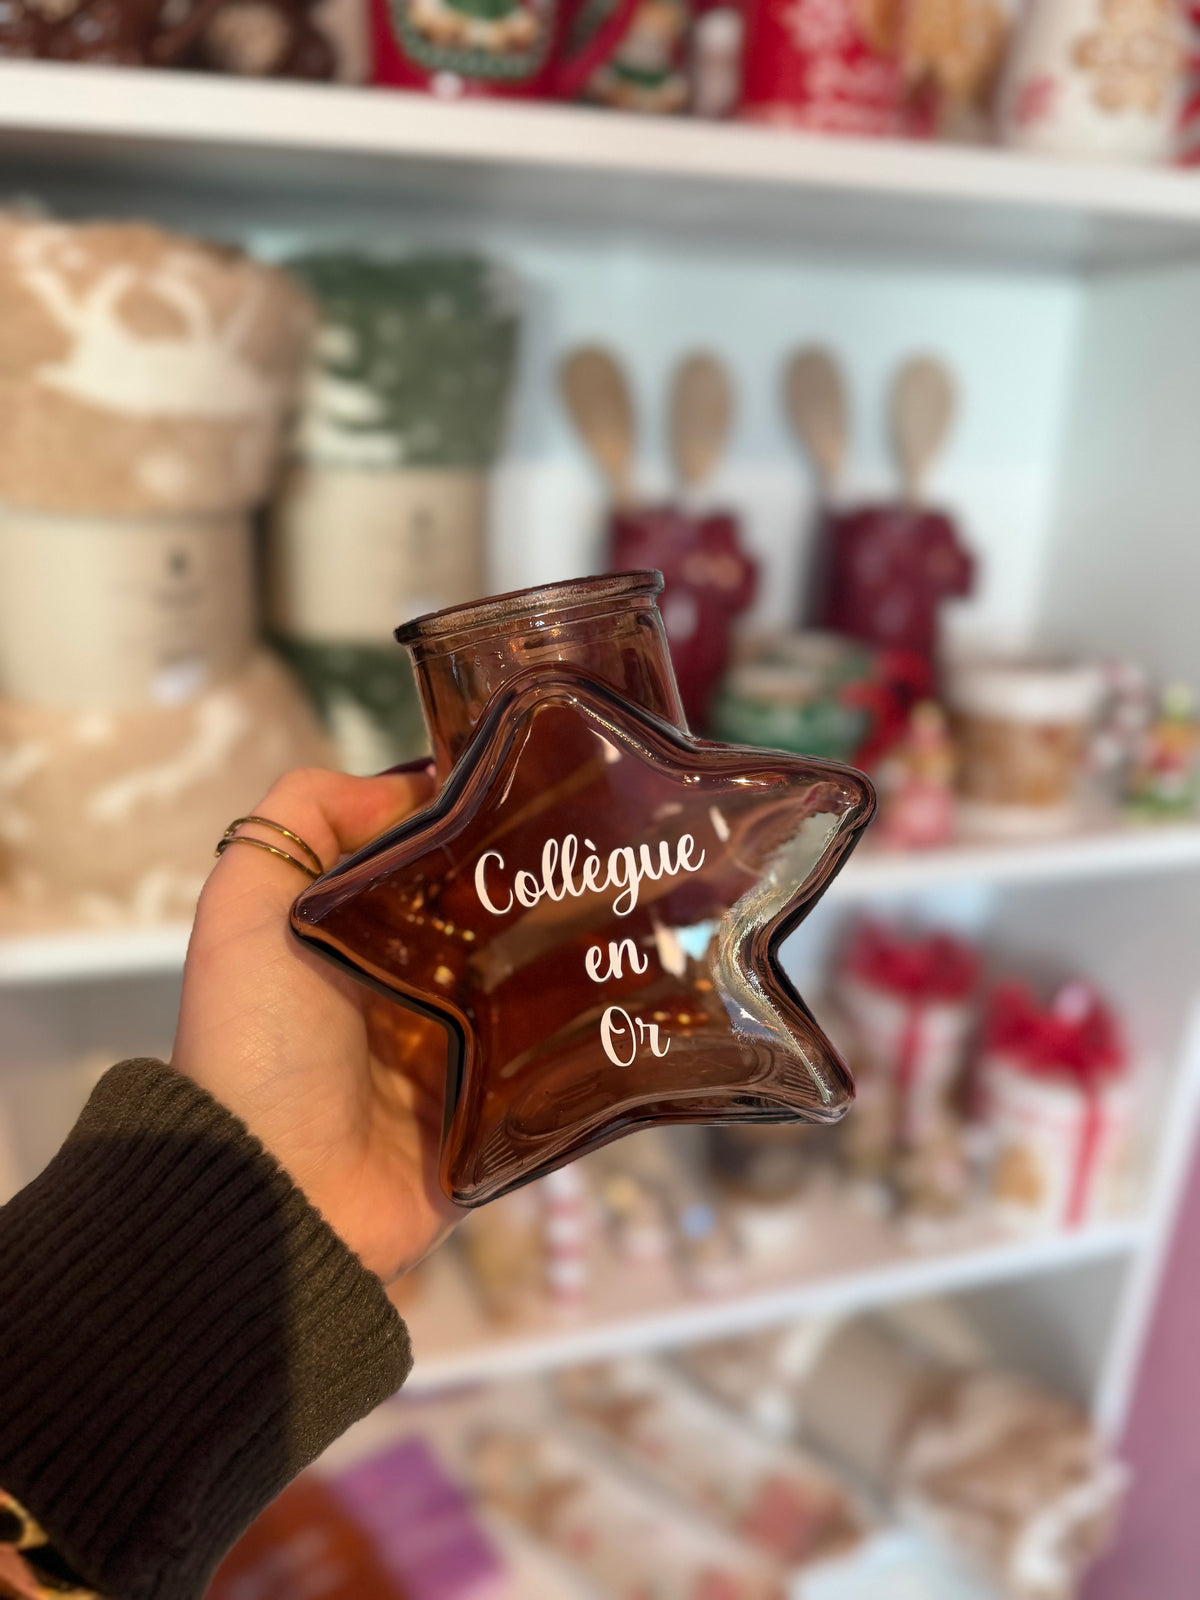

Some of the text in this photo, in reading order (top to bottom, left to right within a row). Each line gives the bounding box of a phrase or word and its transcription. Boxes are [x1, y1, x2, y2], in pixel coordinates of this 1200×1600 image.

[474, 834, 705, 916] Collègue
[585, 938, 648, 983] en
[600, 1006, 671, 1067] Or
